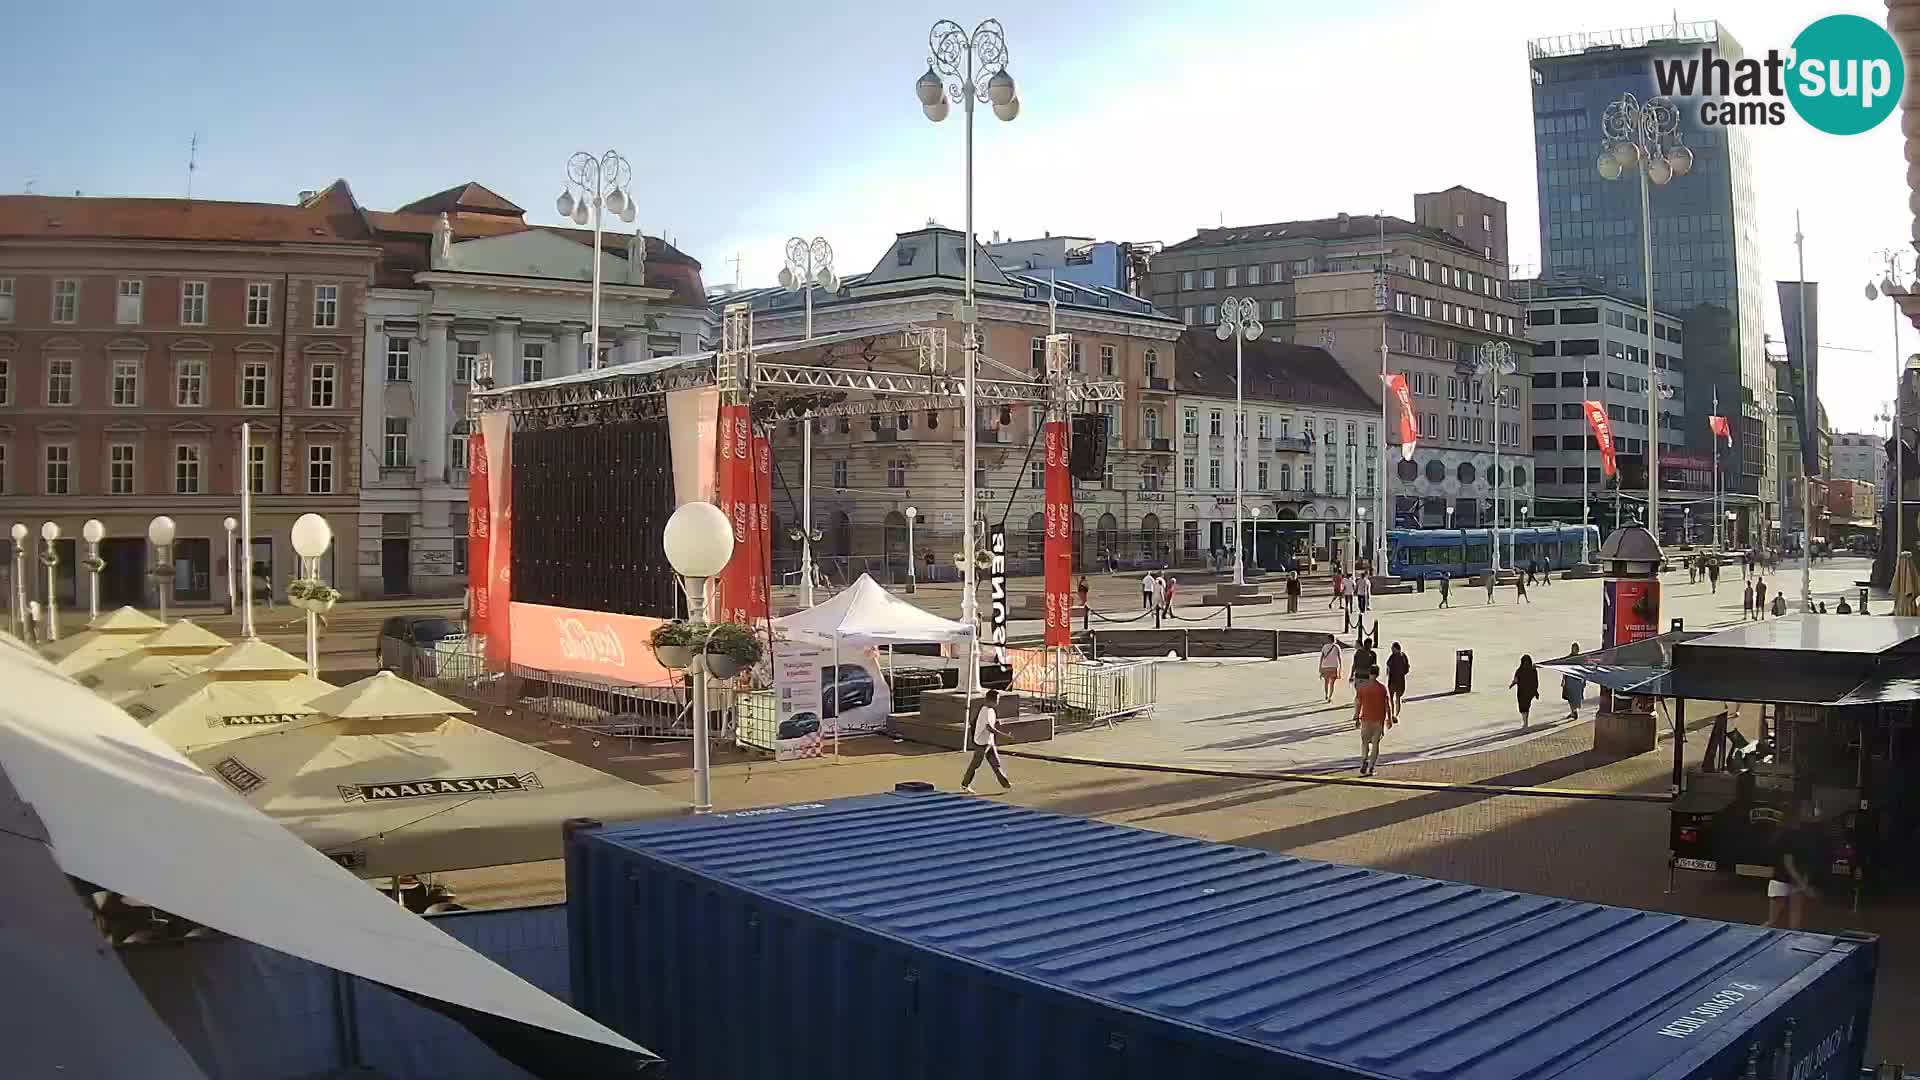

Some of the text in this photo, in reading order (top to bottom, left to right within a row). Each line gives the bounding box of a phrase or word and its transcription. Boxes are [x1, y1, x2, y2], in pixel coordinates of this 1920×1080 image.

[735, 416, 747, 459] Coca-Cola
[1046, 432, 1056, 467] Coca-Cola
[735, 502, 747, 543] Coca-Cola
[1046, 503, 1056, 538] Coca-Cola
[1059, 503, 1069, 538] Coca-Cola
[1046, 592, 1056, 627] Coca-Cola
[1059, 592, 1069, 627] Coca-Cola
[371, 777, 515, 799] MARASKA
